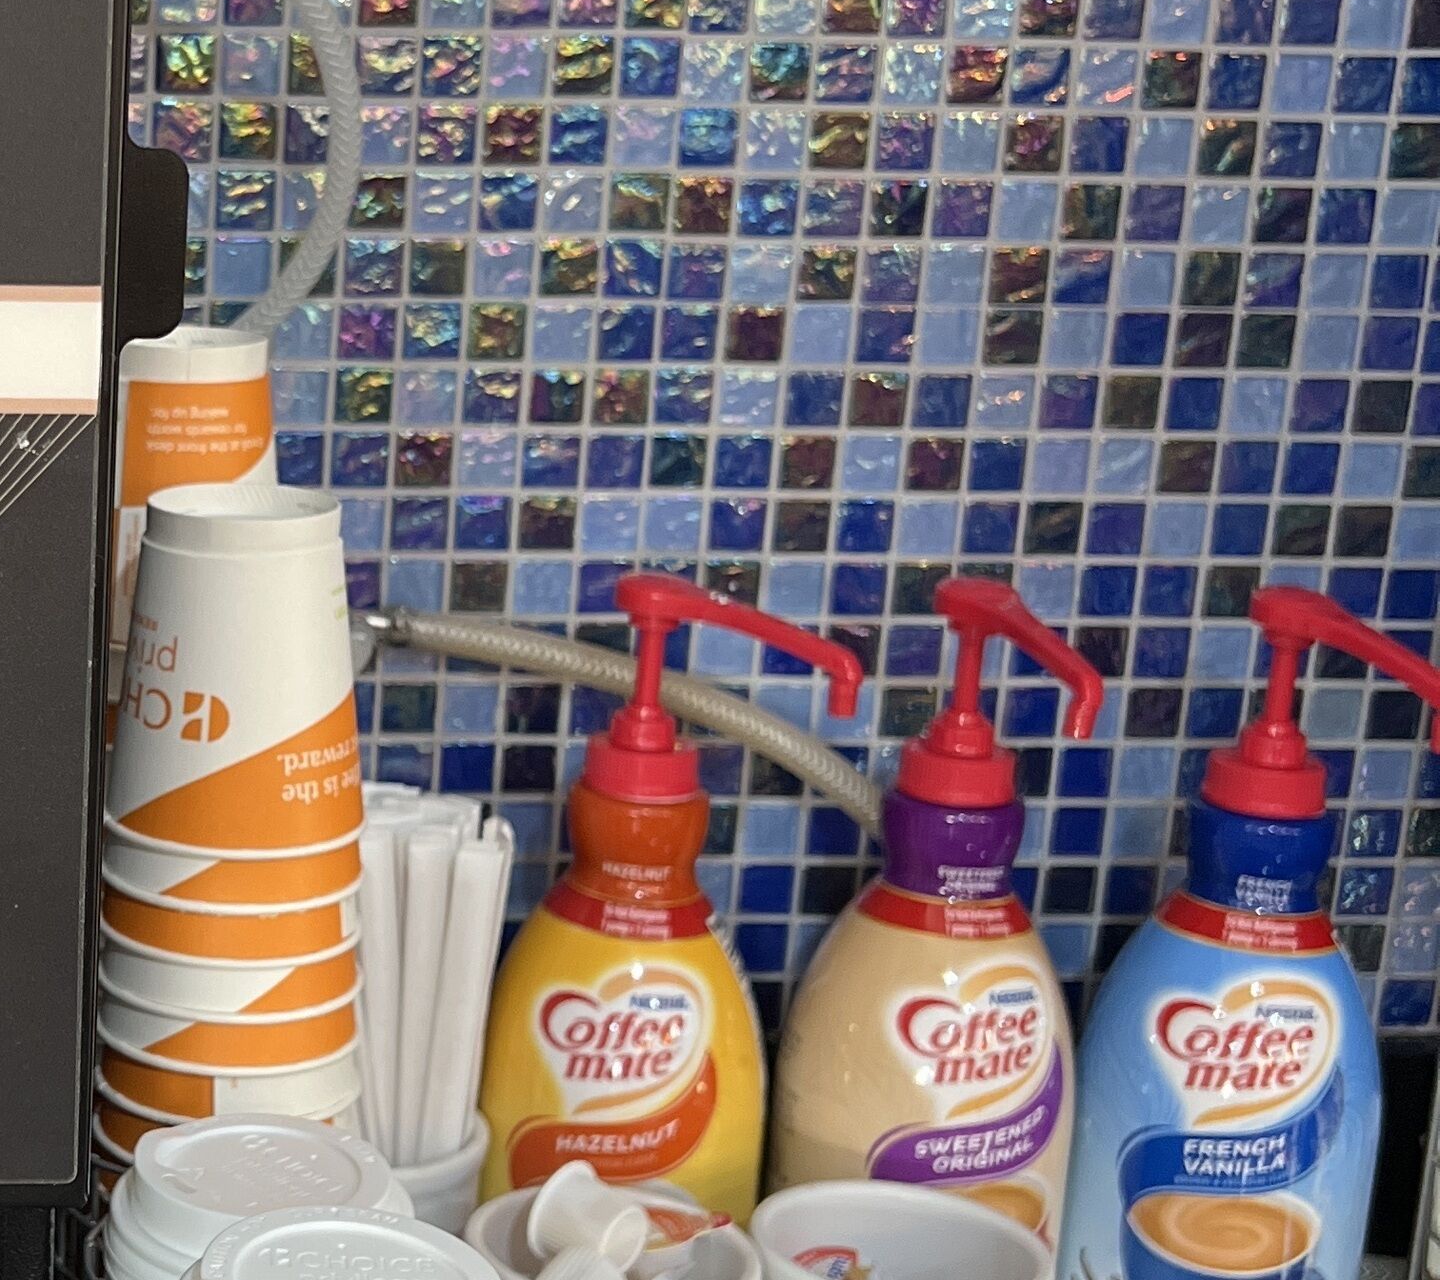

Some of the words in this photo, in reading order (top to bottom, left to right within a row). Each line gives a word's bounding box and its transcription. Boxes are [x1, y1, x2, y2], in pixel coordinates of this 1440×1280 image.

[276, 738, 350, 777] reward.
[281, 779, 320, 806] the
[323, 775, 339, 798] is
[540, 989, 685, 1051] Coffee
[896, 995, 1037, 1058] Coffee
[1155, 997, 1315, 1061] Coffee
[565, 1048, 675, 1081] mate
[934, 1042, 1033, 1085] mate
[1183, 1061, 1303, 1091] mate
[555, 1118, 681, 1154] HAZELNUT
[914, 1104, 1048, 1160] SWEETENED
[1182, 1133, 1287, 1159] FRENCH
[931, 1138, 1035, 1174] ORIGINAL
[1183, 1153, 1285, 1177] VANILLA
[296, 1250, 435, 1273] CHOICE
